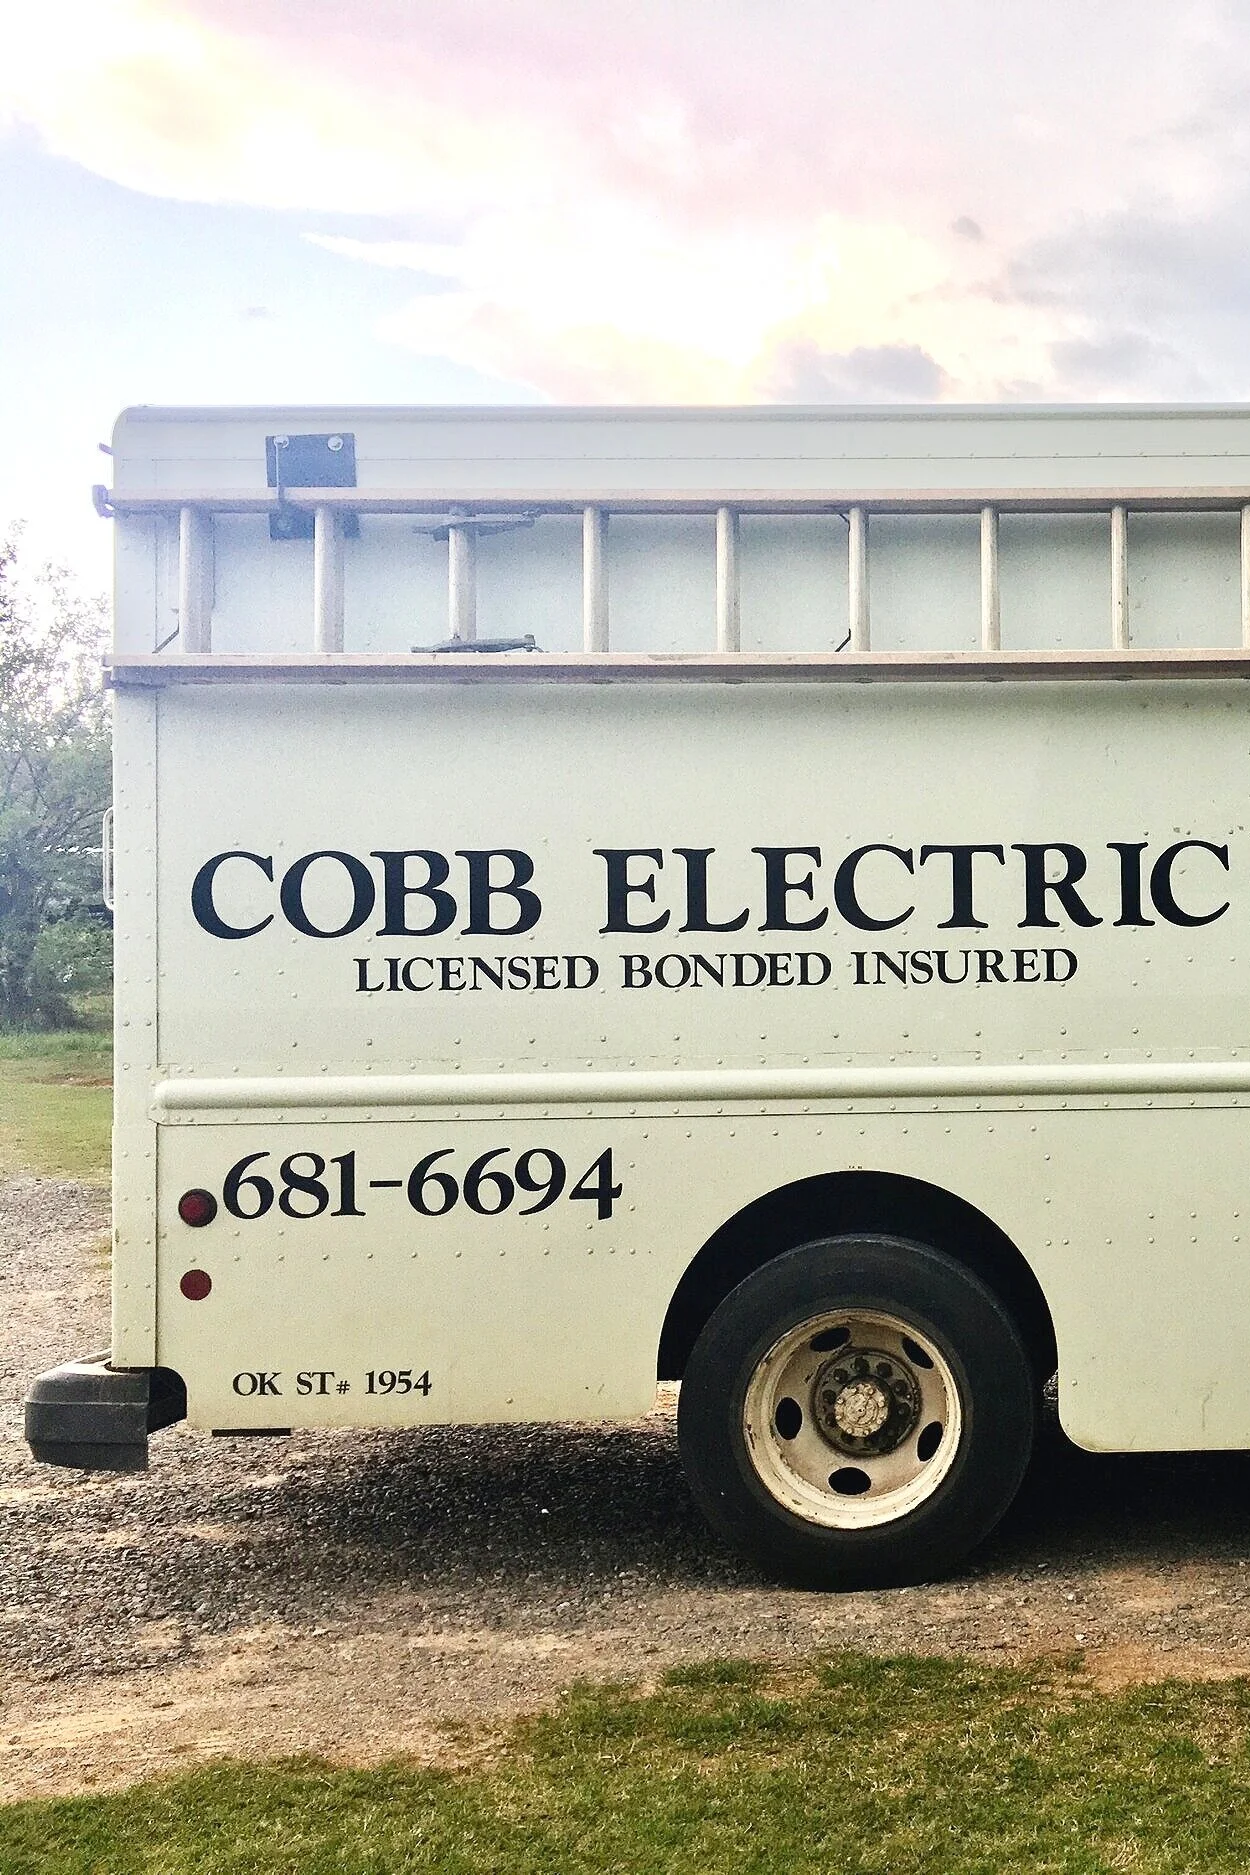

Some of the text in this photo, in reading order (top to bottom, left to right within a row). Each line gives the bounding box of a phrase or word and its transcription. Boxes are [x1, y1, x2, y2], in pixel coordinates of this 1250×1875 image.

[191, 840, 1230, 939] COBB ELECTRIC
[353, 949, 1077, 992] LICENSED BONDED INSURED
[223, 1148, 622, 1220] 681-6694
[233, 1370, 432, 1396] OK ST# 1954
